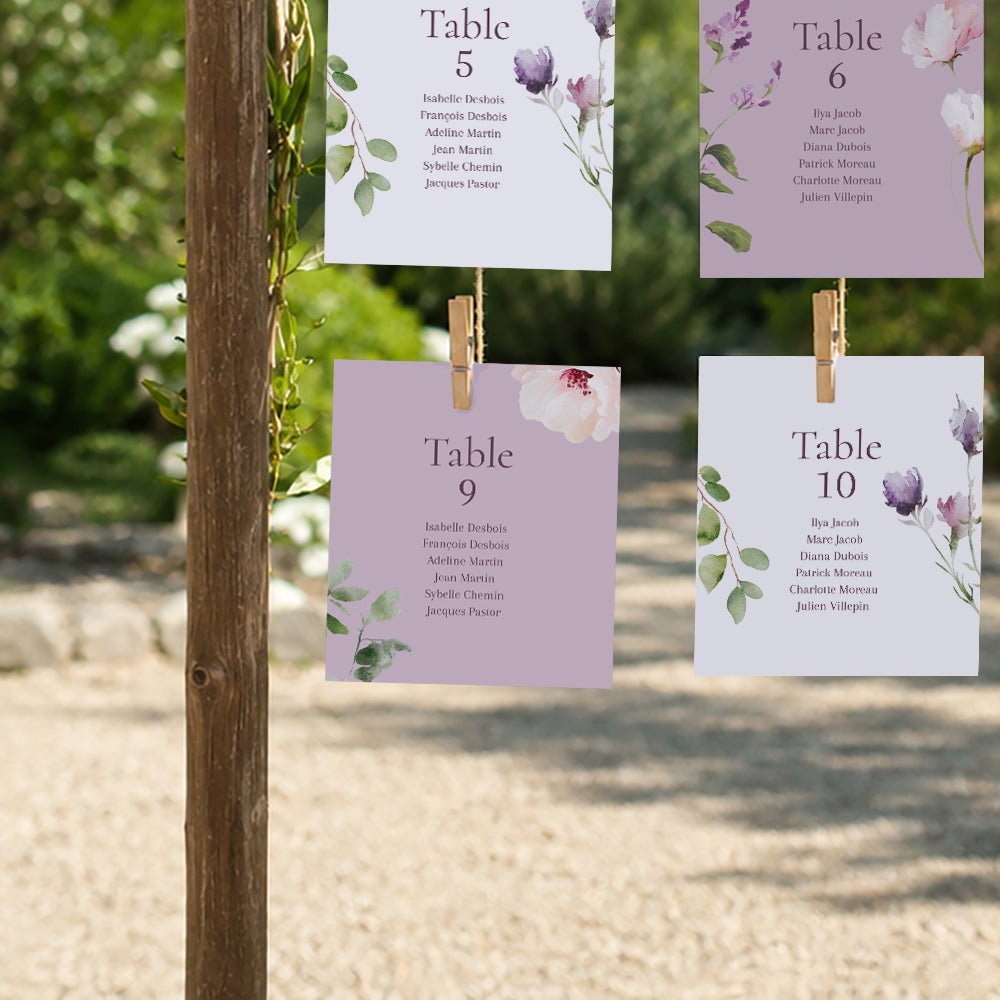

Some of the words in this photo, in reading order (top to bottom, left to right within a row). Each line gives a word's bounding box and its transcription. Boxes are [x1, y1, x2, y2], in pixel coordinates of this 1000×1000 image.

[420, 6, 510, 40] Table
[792, 18, 882, 51] Table
[456, 49, 473, 78] 5
[828, 62, 846, 89] 6
[814, 108, 831, 121] Ilya
[832, 108, 862, 120] Jacob
[810, 125, 836, 135] Marc
[837, 125, 865, 137] Jacob
[432, 144, 455, 156] Jean
[459, 145, 493, 155] Martin
[803, 142, 833, 151] Diana
[836, 142, 871, 151] Dubois
[422, 161, 459, 173] Sybelle
[461, 161, 502, 172] Chemin
[799, 158, 834, 168] Patrick
[837, 159, 875, 168] Moreau
[424, 178, 465, 190] Jacques
[467, 179, 500, 189] Pastor
[793, 175, 840, 185] Charlotte
[843, 175, 881, 185] Moreau
[800, 192, 830, 204] Julien
[834, 192, 873, 205] Villepin
[791, 427, 882, 460] Table
[424, 435, 513, 469] Table
[817, 471, 856, 499] 10
[459, 479, 476, 506] 9
[426, 521, 464, 533] Isabelle
[468, 522, 507, 534] Desbois
[423, 538, 467, 551] François
[470, 539, 509, 551] Desbois
[807, 534, 833, 544] Marc
[834, 534, 863, 546] Jacob
[427, 555, 466, 566] Adeline
[469, 556, 503, 567] Martin
[800, 551, 830, 561] Diana
[834, 551, 868, 561] Dubois
[796, 568, 831, 577] Patrick
[834, 568, 872, 577] Moreau
[424, 589, 460, 601] Sybelle
[463, 590, 504, 600] Chemin
[789, 584, 836, 594] Charlotte
[839, 585, 878, 595] Moreau
[425, 605, 466, 619] Jacques
[469, 607, 502, 617] Pastor
[795, 601, 827, 613] Julien
[830, 601, 869, 614] Villepin
